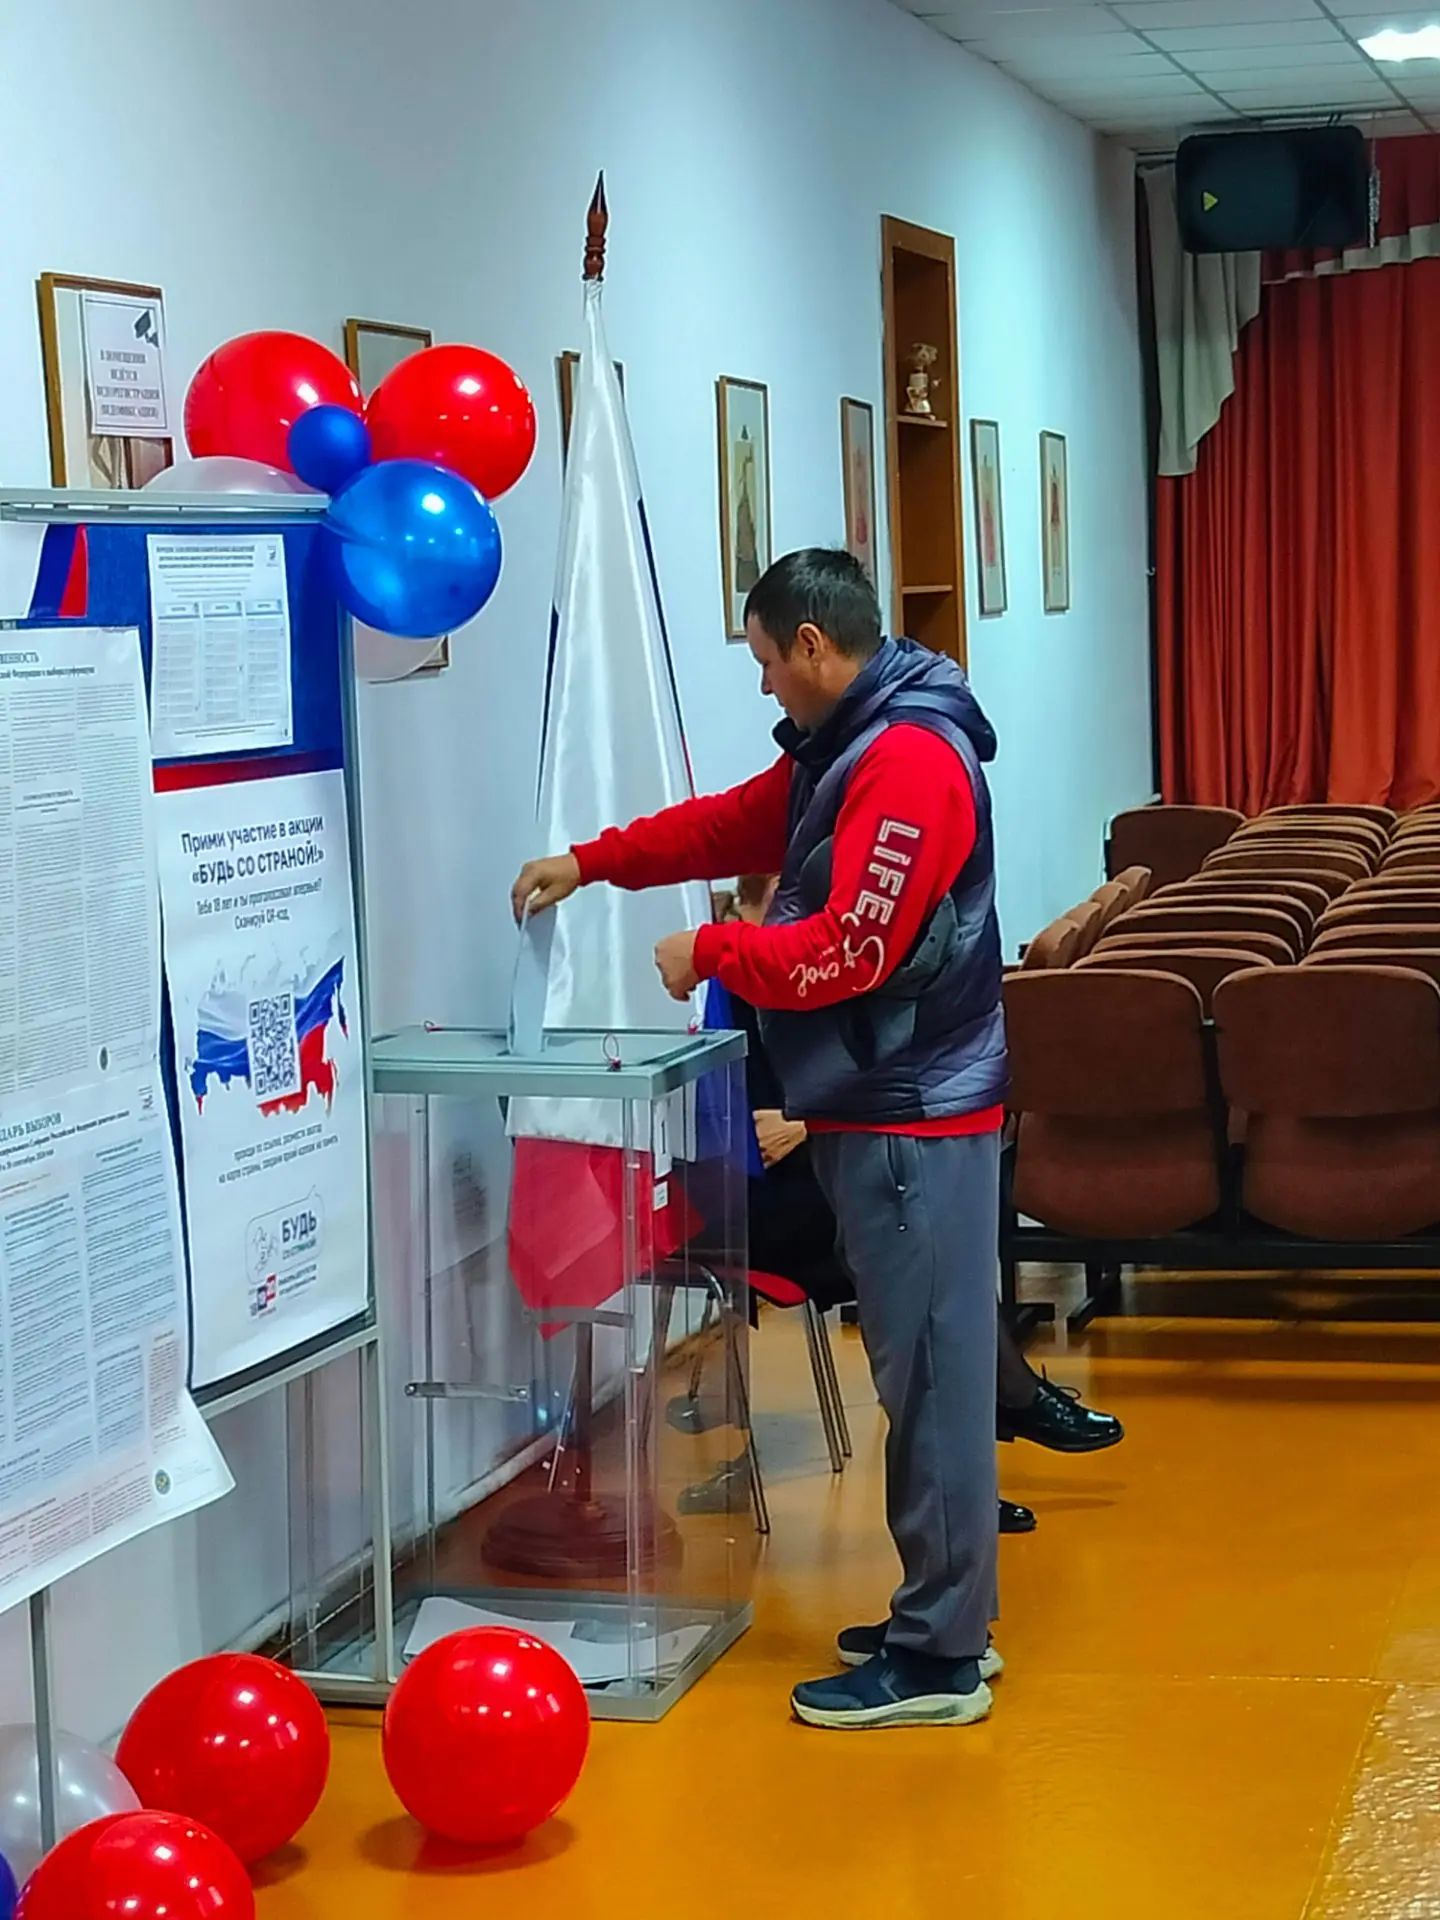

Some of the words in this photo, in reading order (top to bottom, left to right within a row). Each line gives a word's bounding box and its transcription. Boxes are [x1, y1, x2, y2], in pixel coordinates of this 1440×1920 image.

[182, 833, 226, 857] Прими
[227, 822, 278, 851] участие
[280, 822, 286, 838] в
[288, 815, 324, 836] акции
[192, 860, 235, 885] «БУДЬ
[237, 855, 255, 877] СО
[257, 840, 324, 874] СТРАНОЙ!»
[855, 818, 921, 926] LIFE
[282, 1209, 317, 1243] БУДЬ
